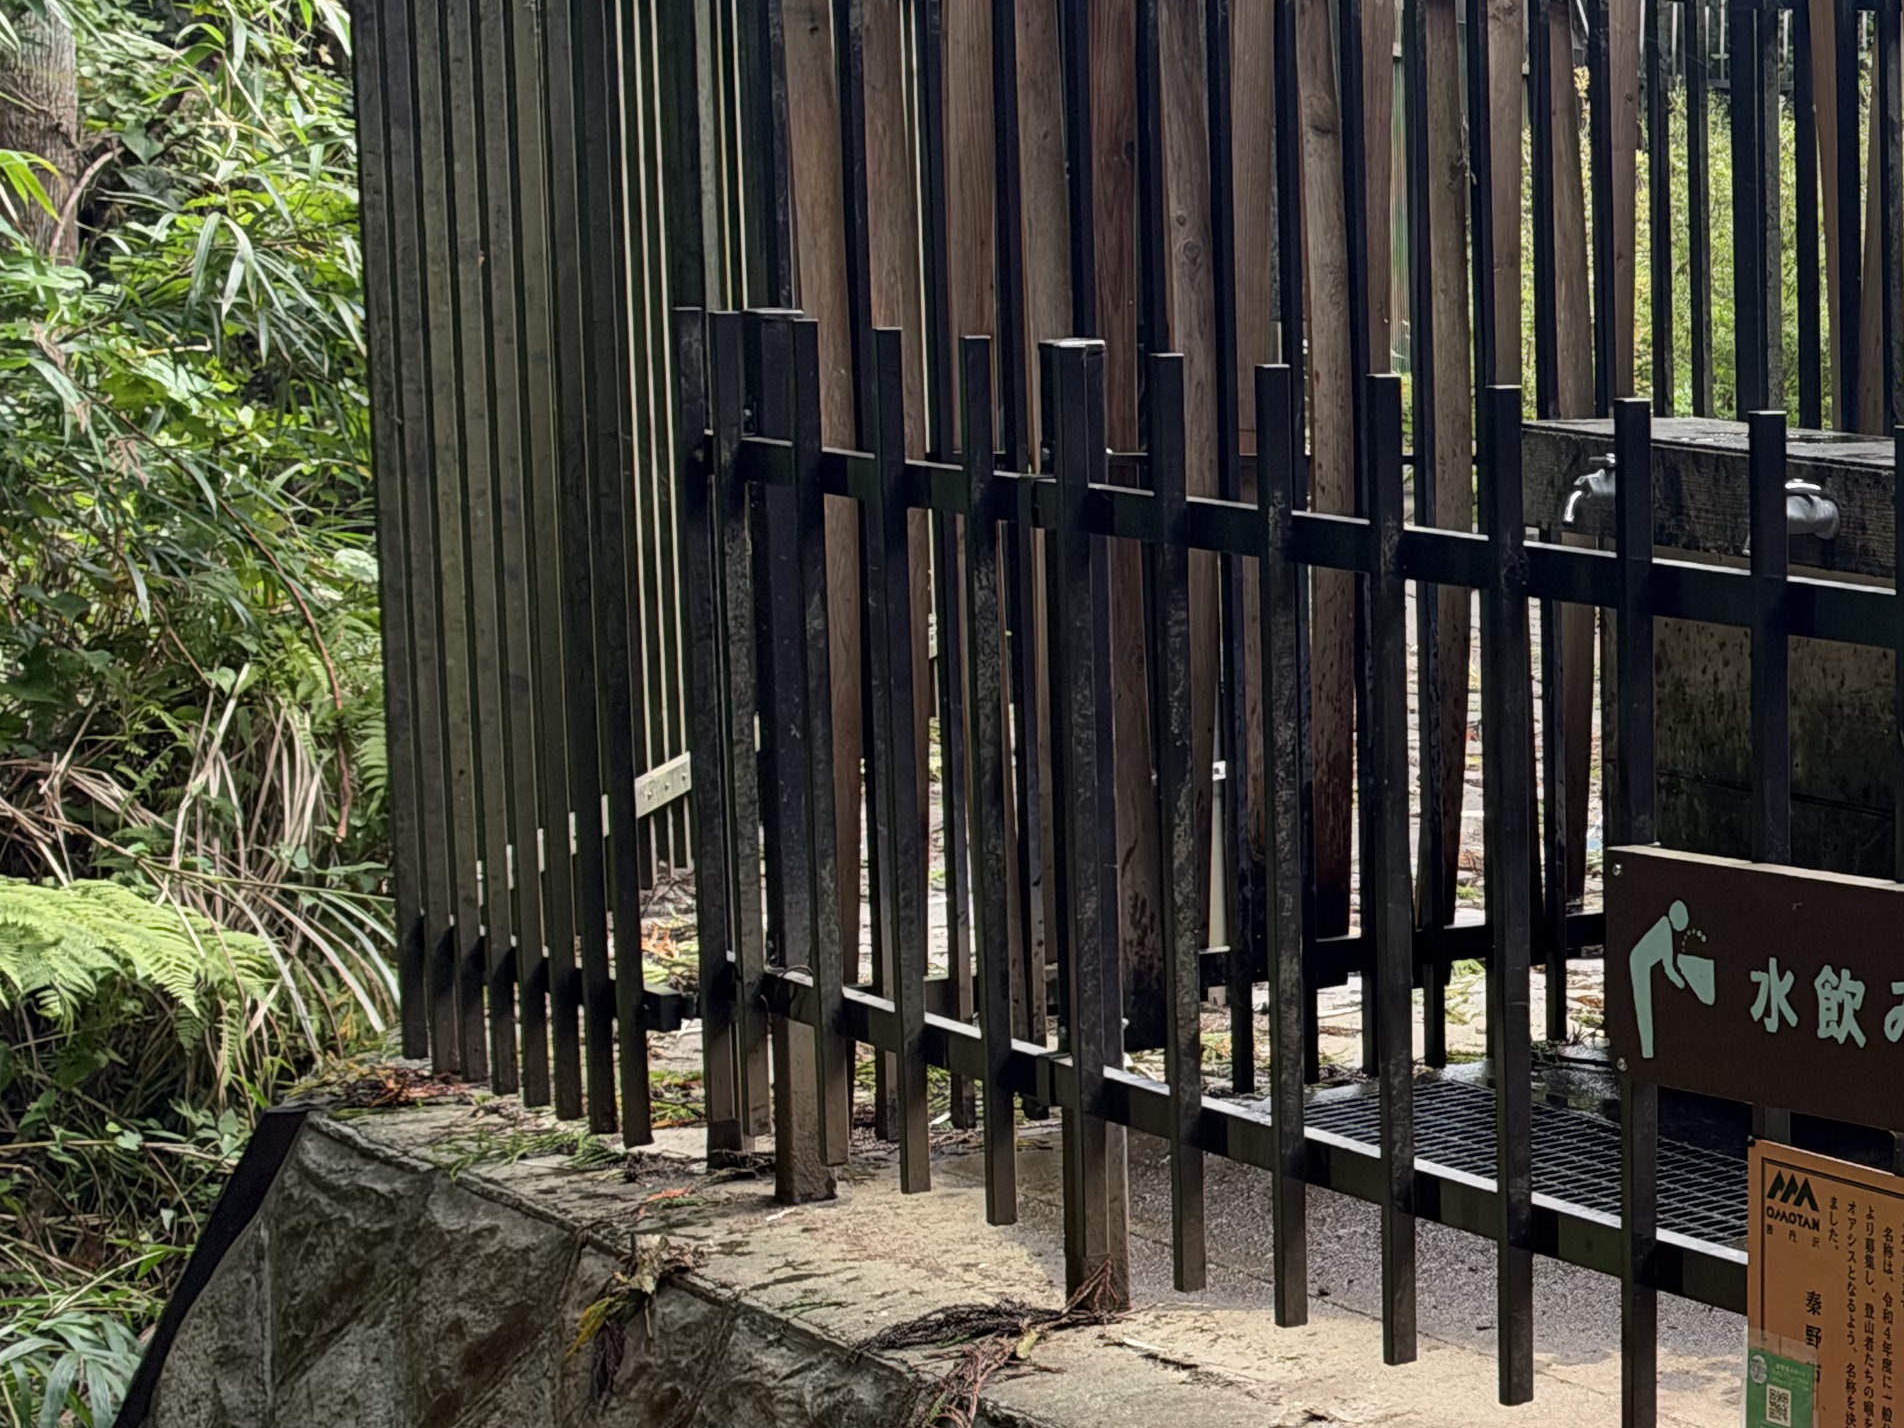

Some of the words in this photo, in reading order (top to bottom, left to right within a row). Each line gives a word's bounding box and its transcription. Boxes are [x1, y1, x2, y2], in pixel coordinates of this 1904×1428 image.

[1766, 1205, 1821, 1233] OMOTAN
[1827, 1195, 1840, 1251] ました。
